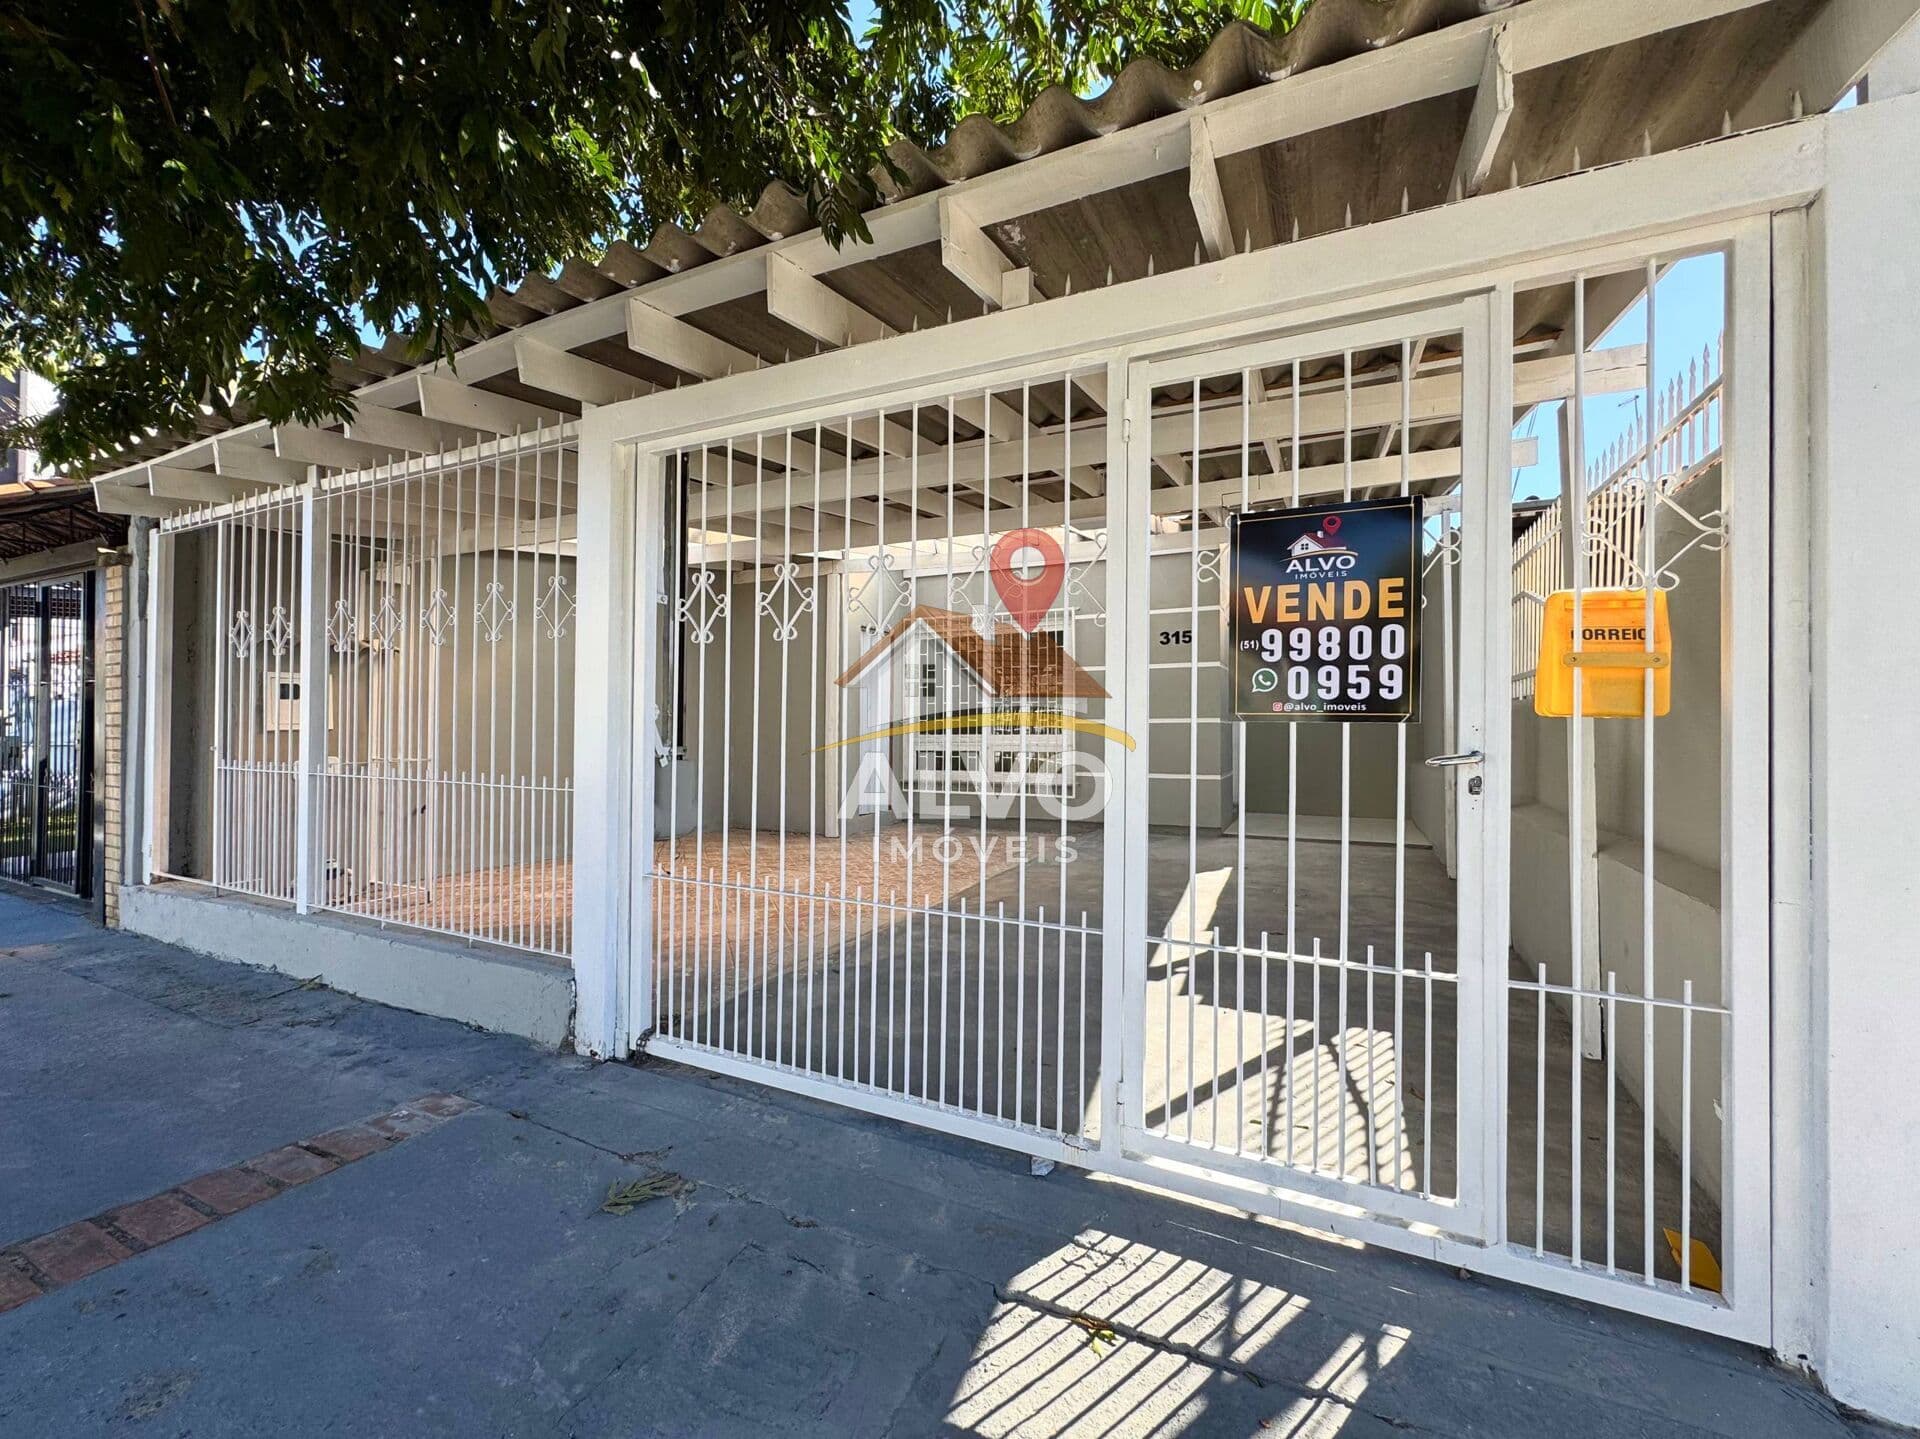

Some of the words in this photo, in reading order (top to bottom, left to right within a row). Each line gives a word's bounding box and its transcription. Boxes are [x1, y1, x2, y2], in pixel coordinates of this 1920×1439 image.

[1286, 555, 1356, 573] ALVO
[1243, 577, 1405, 624] VENDE
[1160, 630, 1193, 645] 315
[1240, 640, 1260, 651] (51)
[1261, 624, 1406, 663] 99800
[1571, 628, 1648, 641] ORREIO
[1287, 664, 1404, 700] 0959
[1283, 703, 1367, 713] @alvo_imoveis
